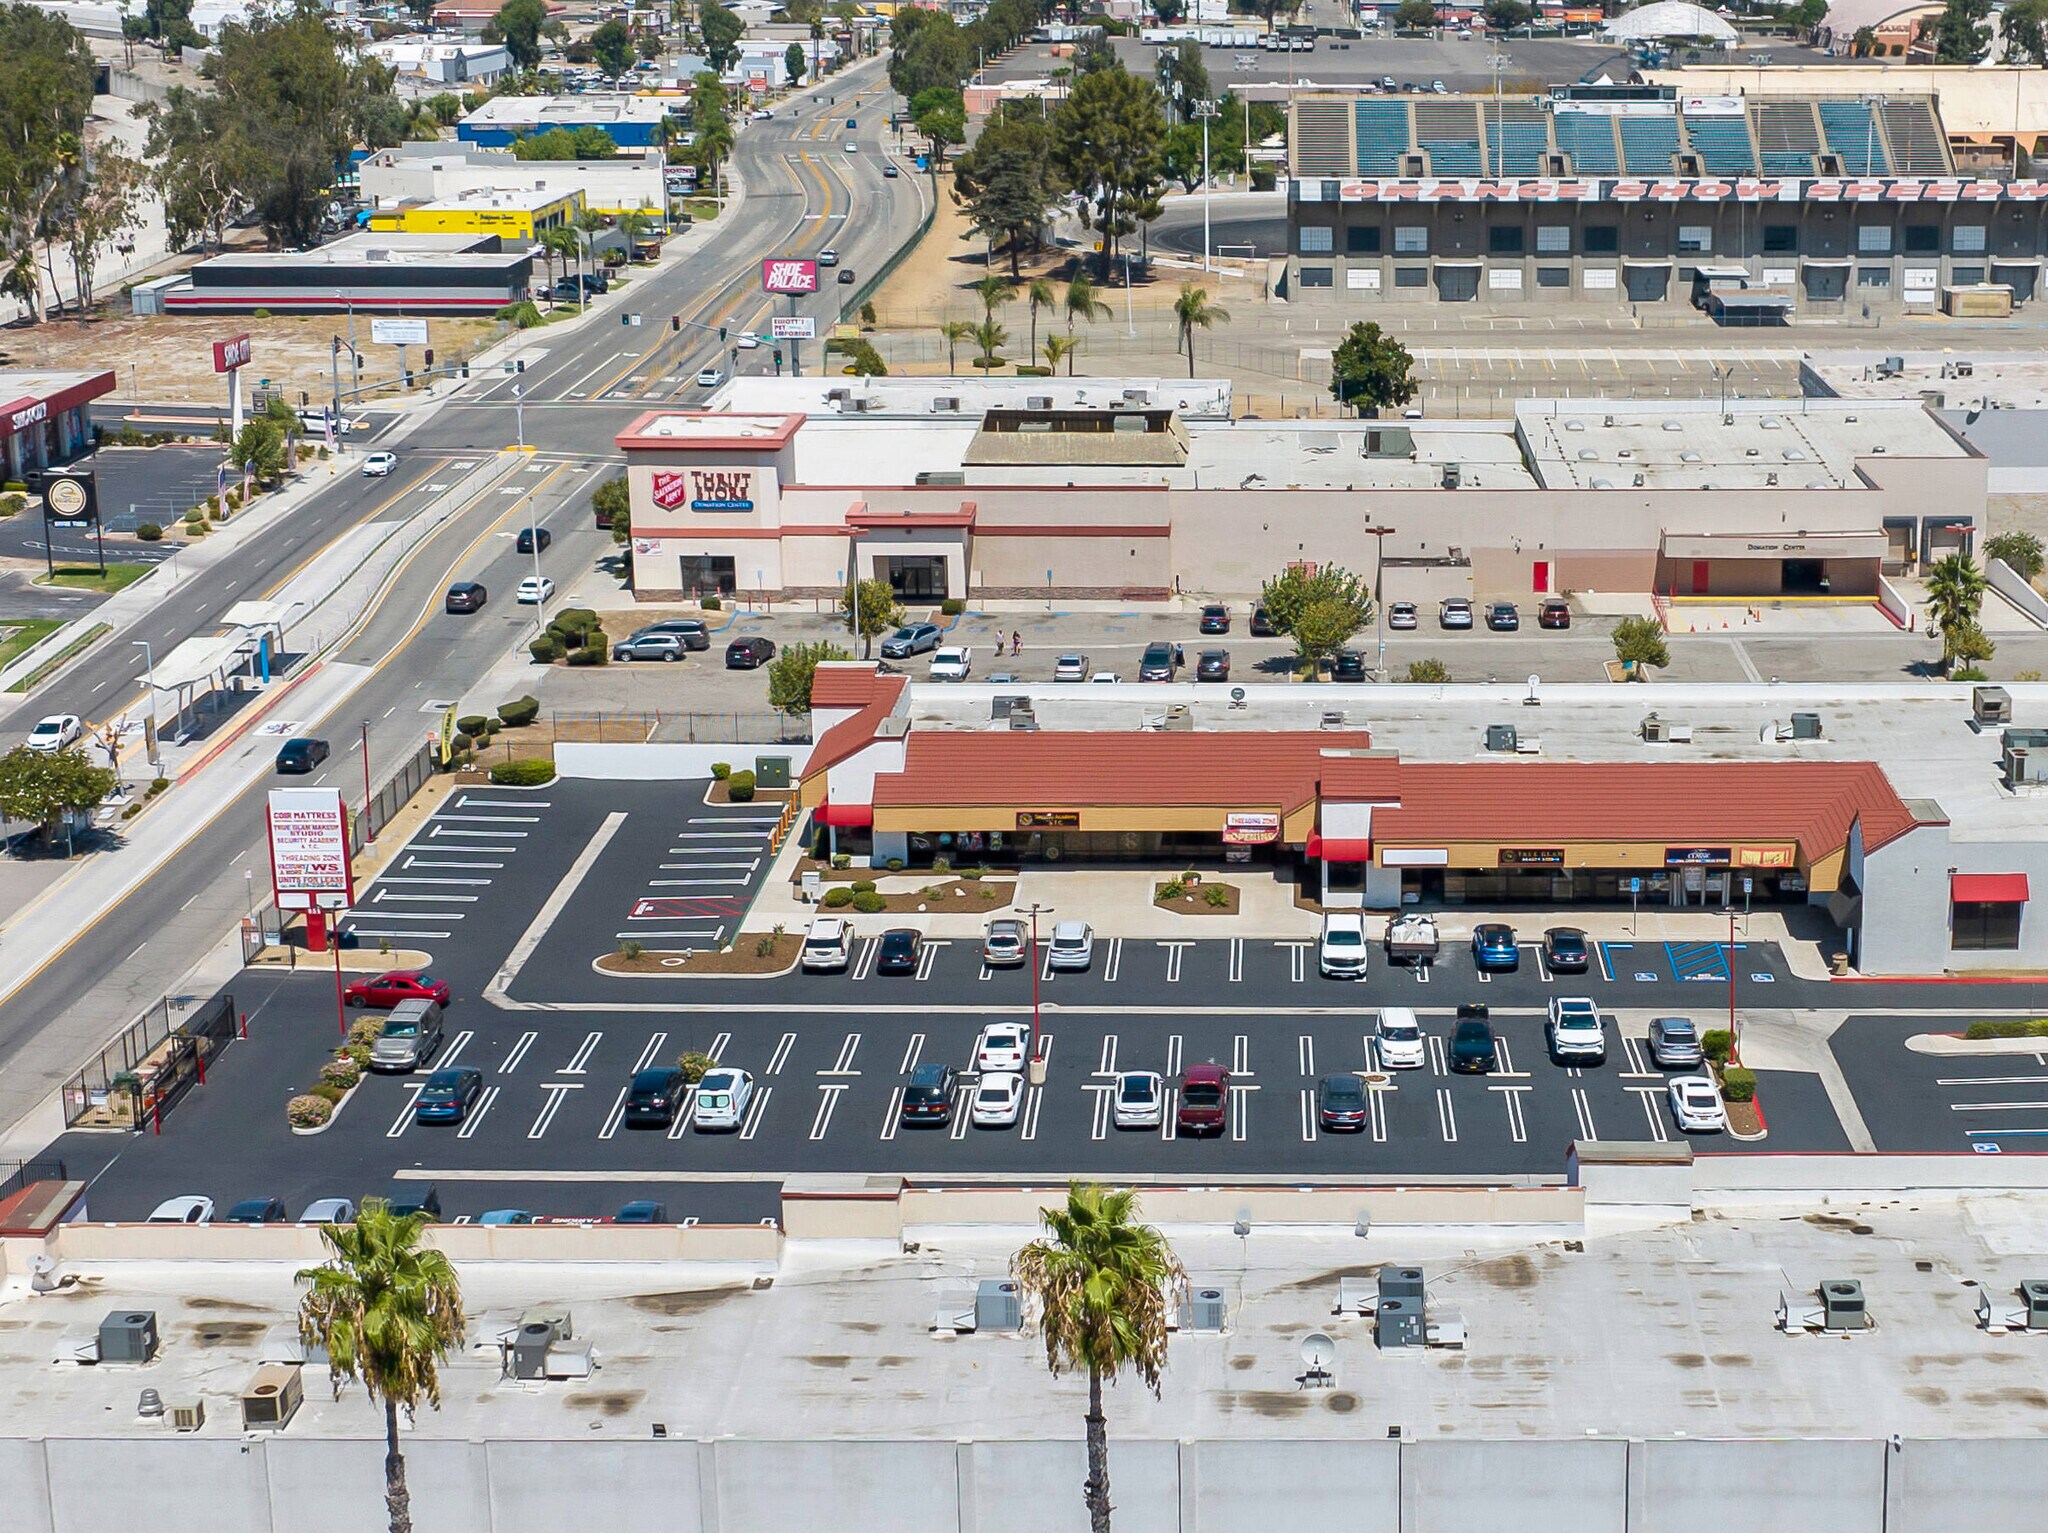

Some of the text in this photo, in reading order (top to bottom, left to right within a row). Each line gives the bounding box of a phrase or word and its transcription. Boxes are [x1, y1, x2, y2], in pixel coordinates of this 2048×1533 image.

[1340, 184, 1590, 198] ORANGE
[1609, 184, 1783, 198] SHOW
[772, 263, 805, 276] SHOE
[767, 275, 814, 288] PALACE
[658, 474, 671, 486] THE
[691, 471, 751, 492] THRIFT
[653, 479, 683, 500] SALVATION
[665, 487, 682, 504] ARMY
[696, 486, 747, 500] STORE
[1741, 850, 1761, 864] NOW
